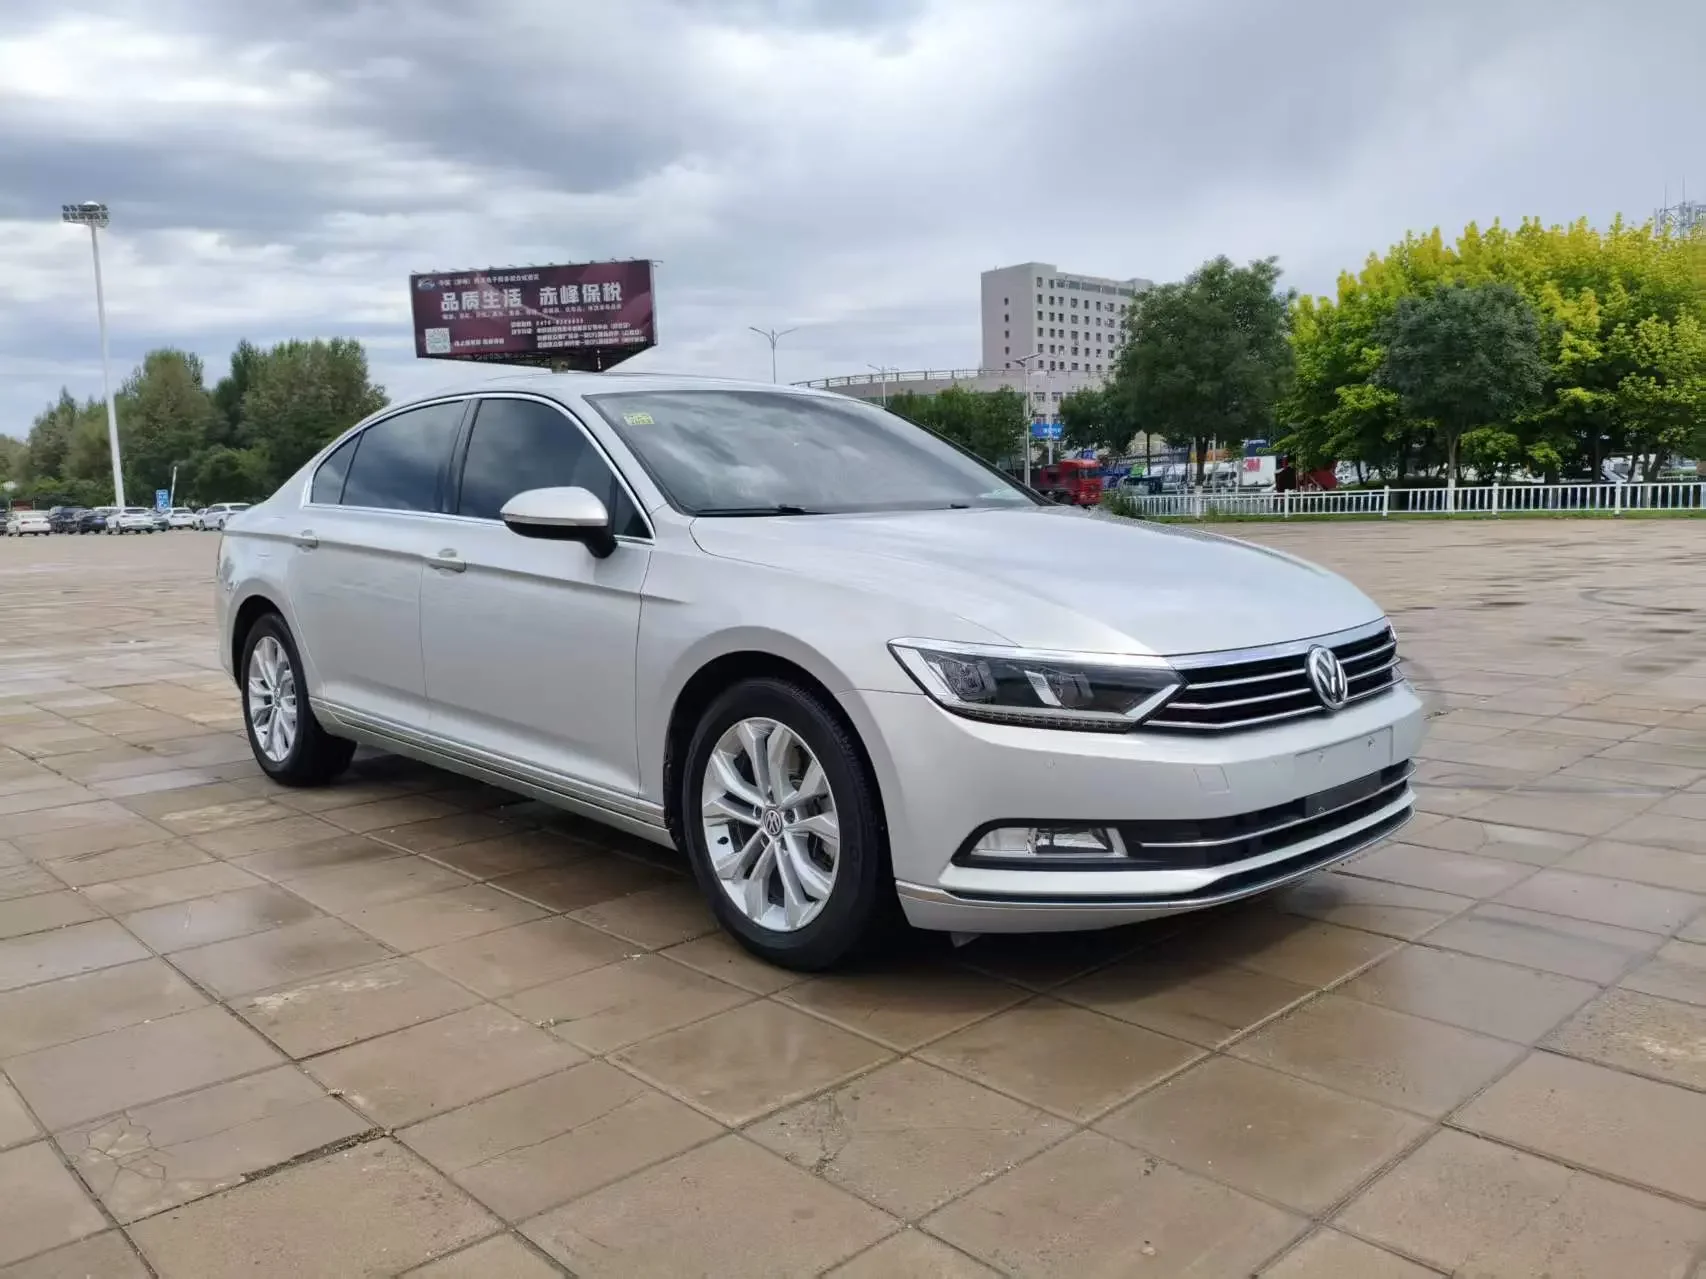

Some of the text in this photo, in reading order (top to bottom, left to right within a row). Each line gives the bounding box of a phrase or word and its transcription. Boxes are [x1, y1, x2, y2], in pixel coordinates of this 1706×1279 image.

[440, 282, 622, 312] 品质生活 赤峰保税
